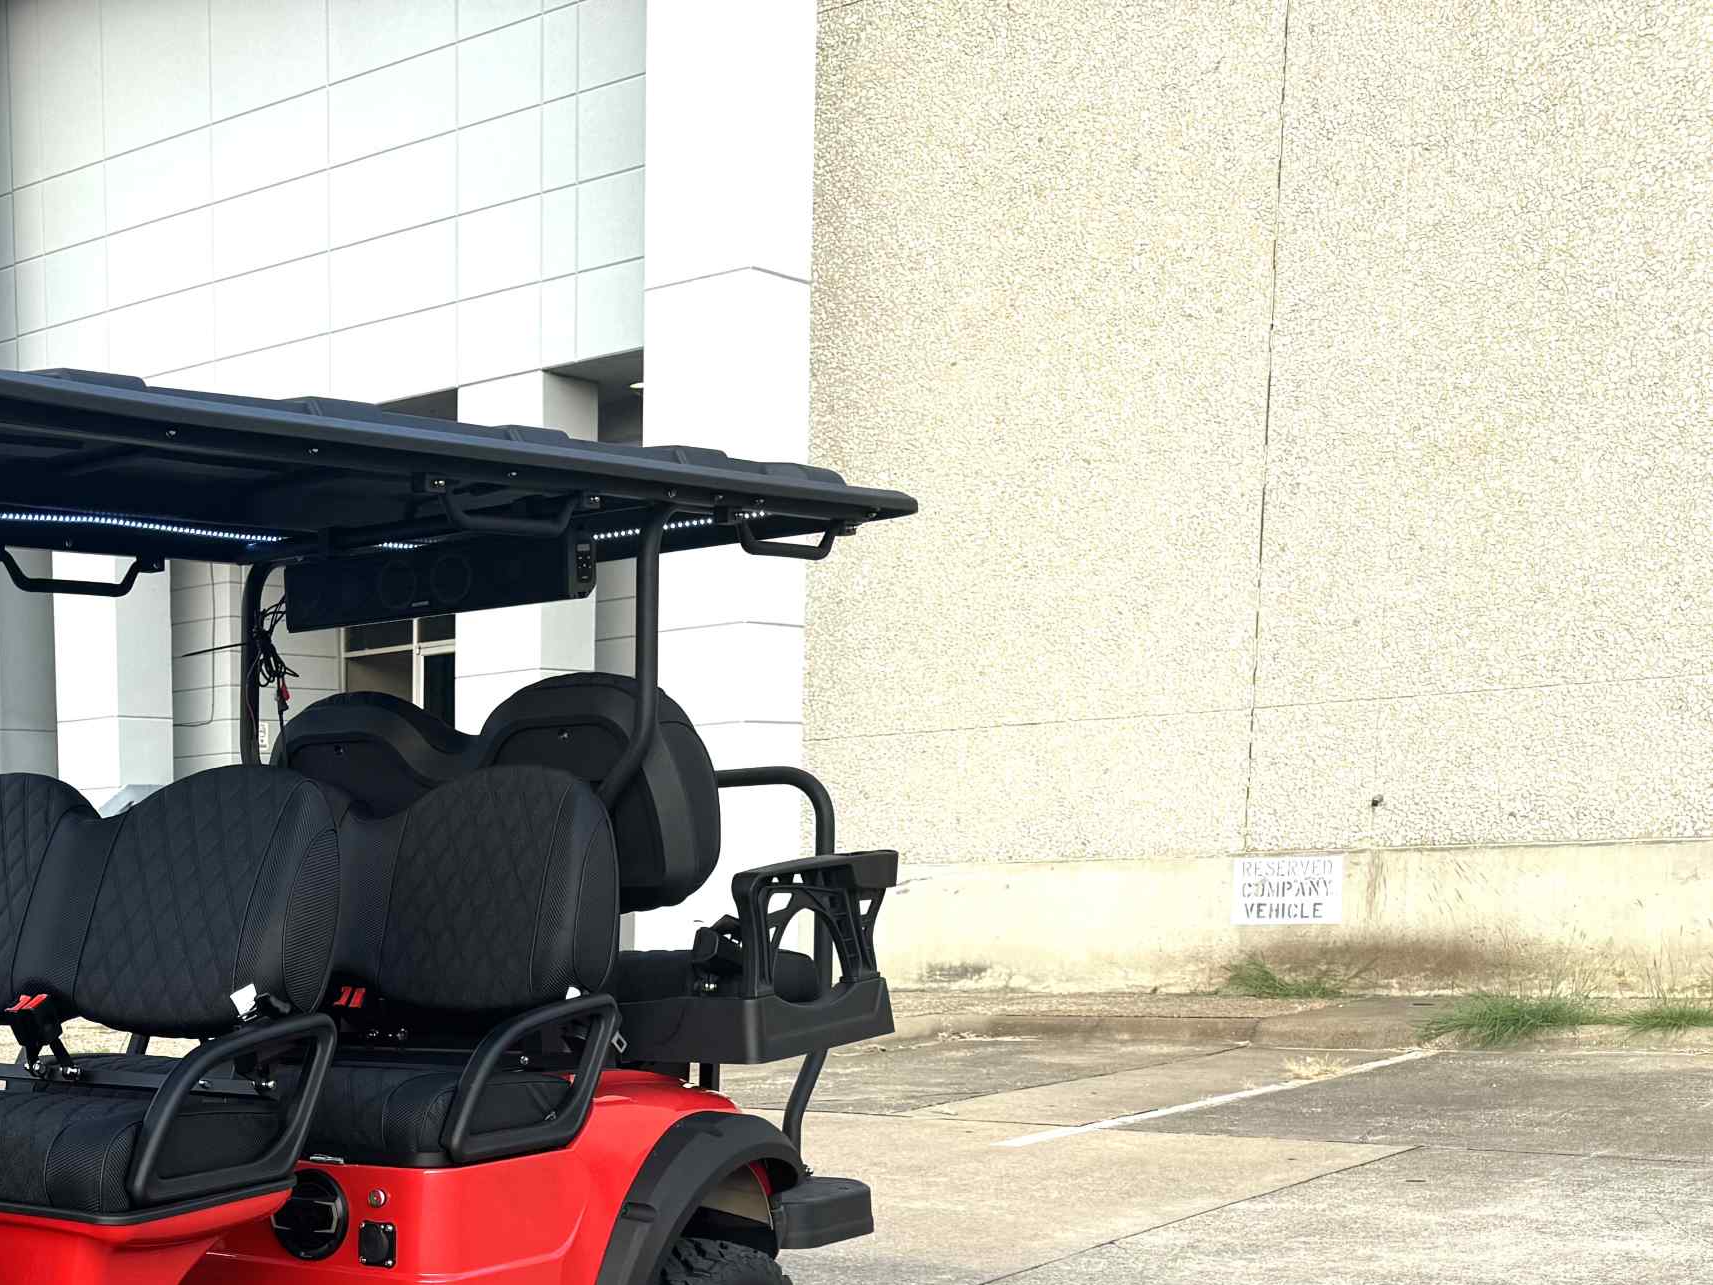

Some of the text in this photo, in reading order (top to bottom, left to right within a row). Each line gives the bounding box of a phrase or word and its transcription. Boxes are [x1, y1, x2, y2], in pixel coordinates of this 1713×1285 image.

[1242, 859, 1333, 877] RESERVED
[1242, 878, 1333, 898] COMPANY
[1244, 902, 1324, 919] VEHICLE
